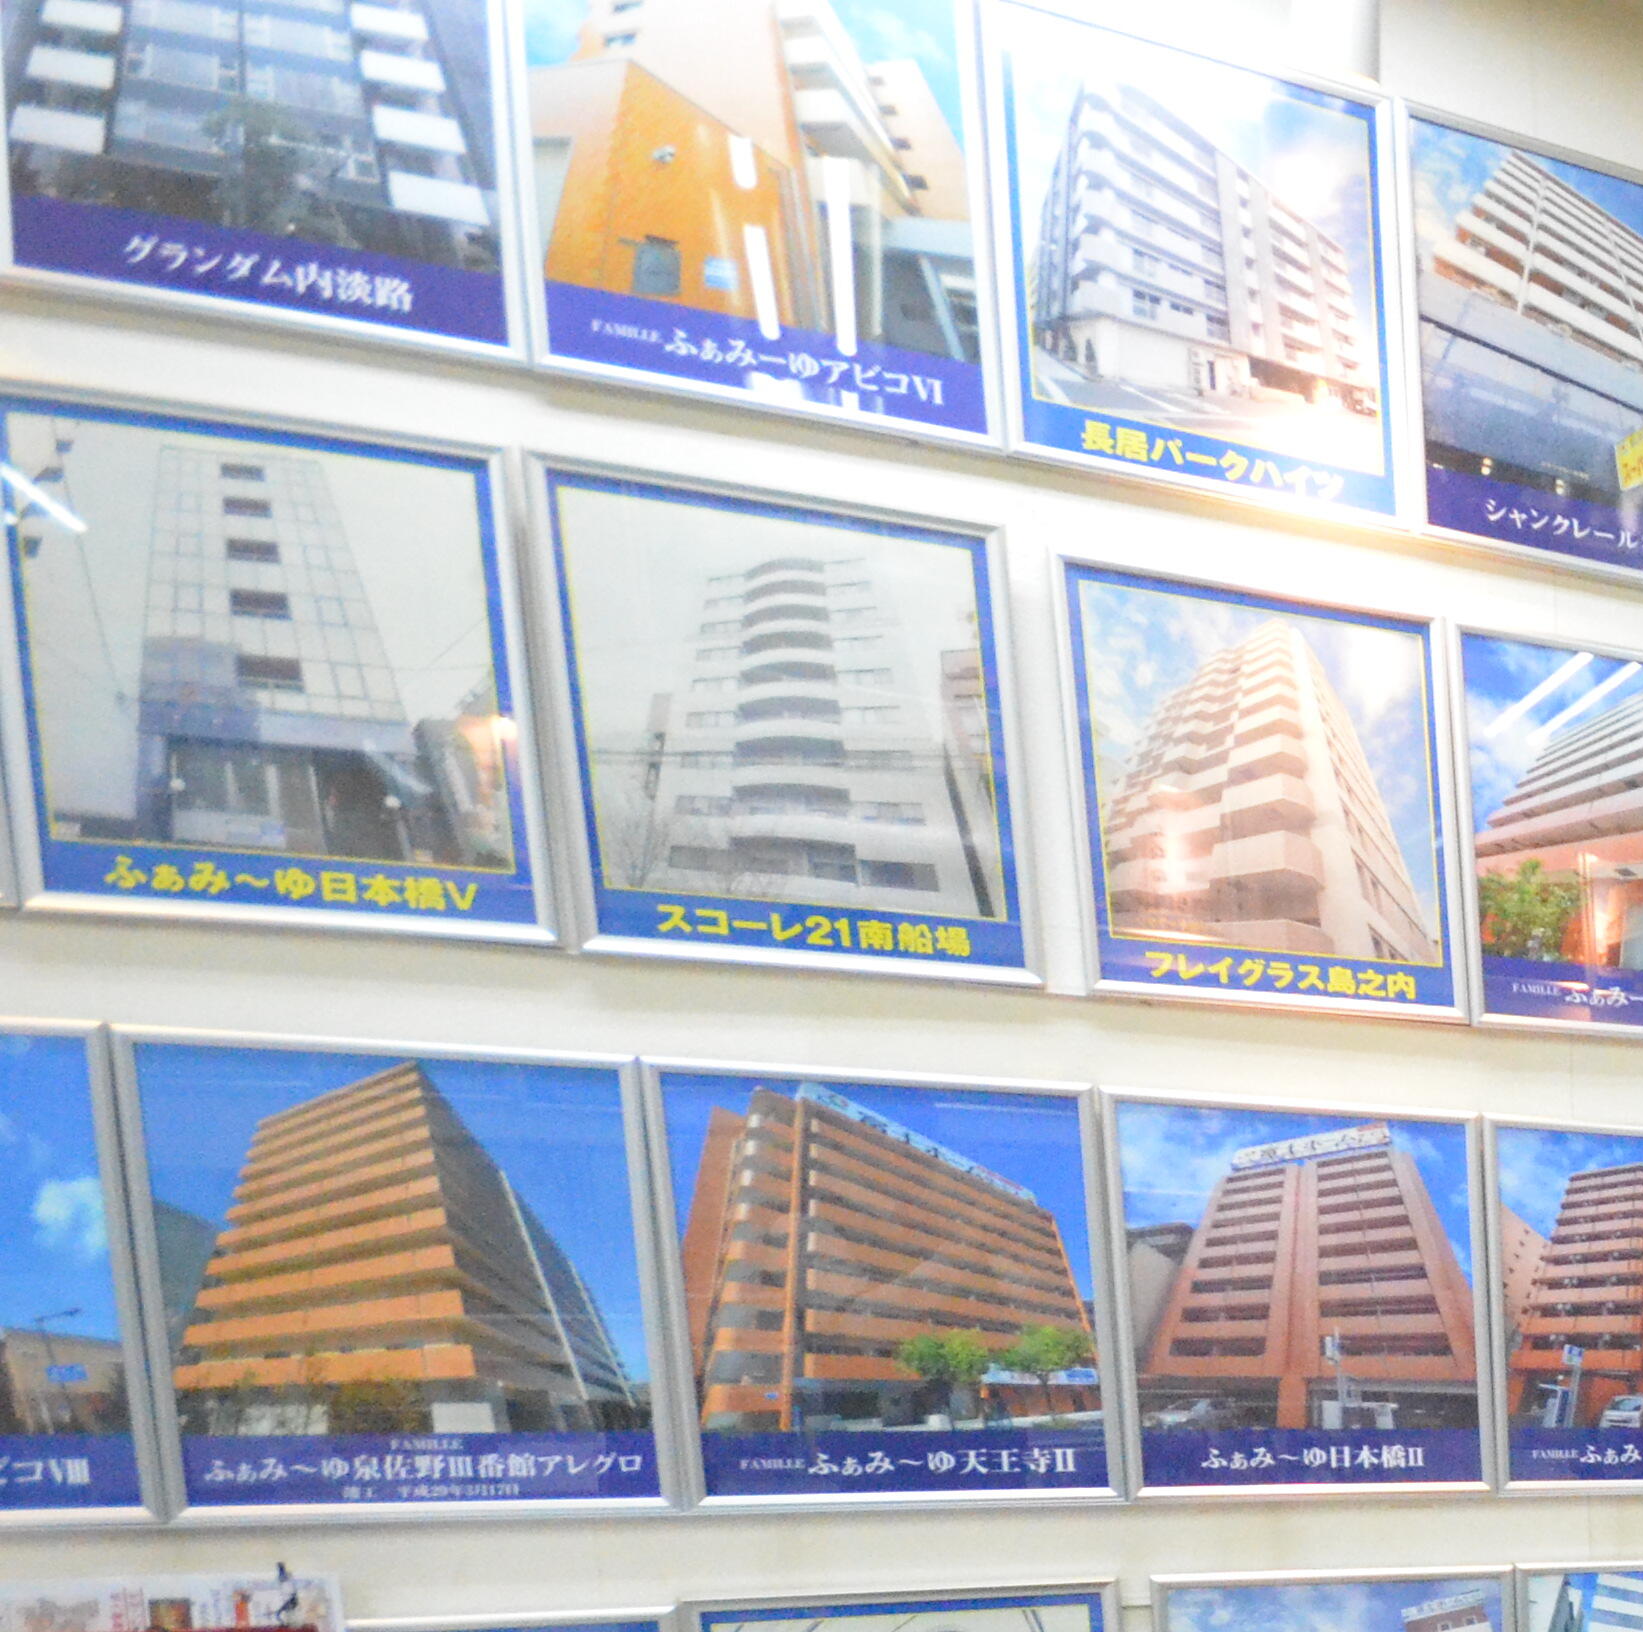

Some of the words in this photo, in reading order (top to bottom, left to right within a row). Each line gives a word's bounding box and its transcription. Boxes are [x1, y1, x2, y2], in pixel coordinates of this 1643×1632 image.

[123, 233, 414, 314] グランダム内淡路
[1082, 420, 1345, 500] 長居パークハイツ
[657, 903, 971, 957] スコーレ21南船場
